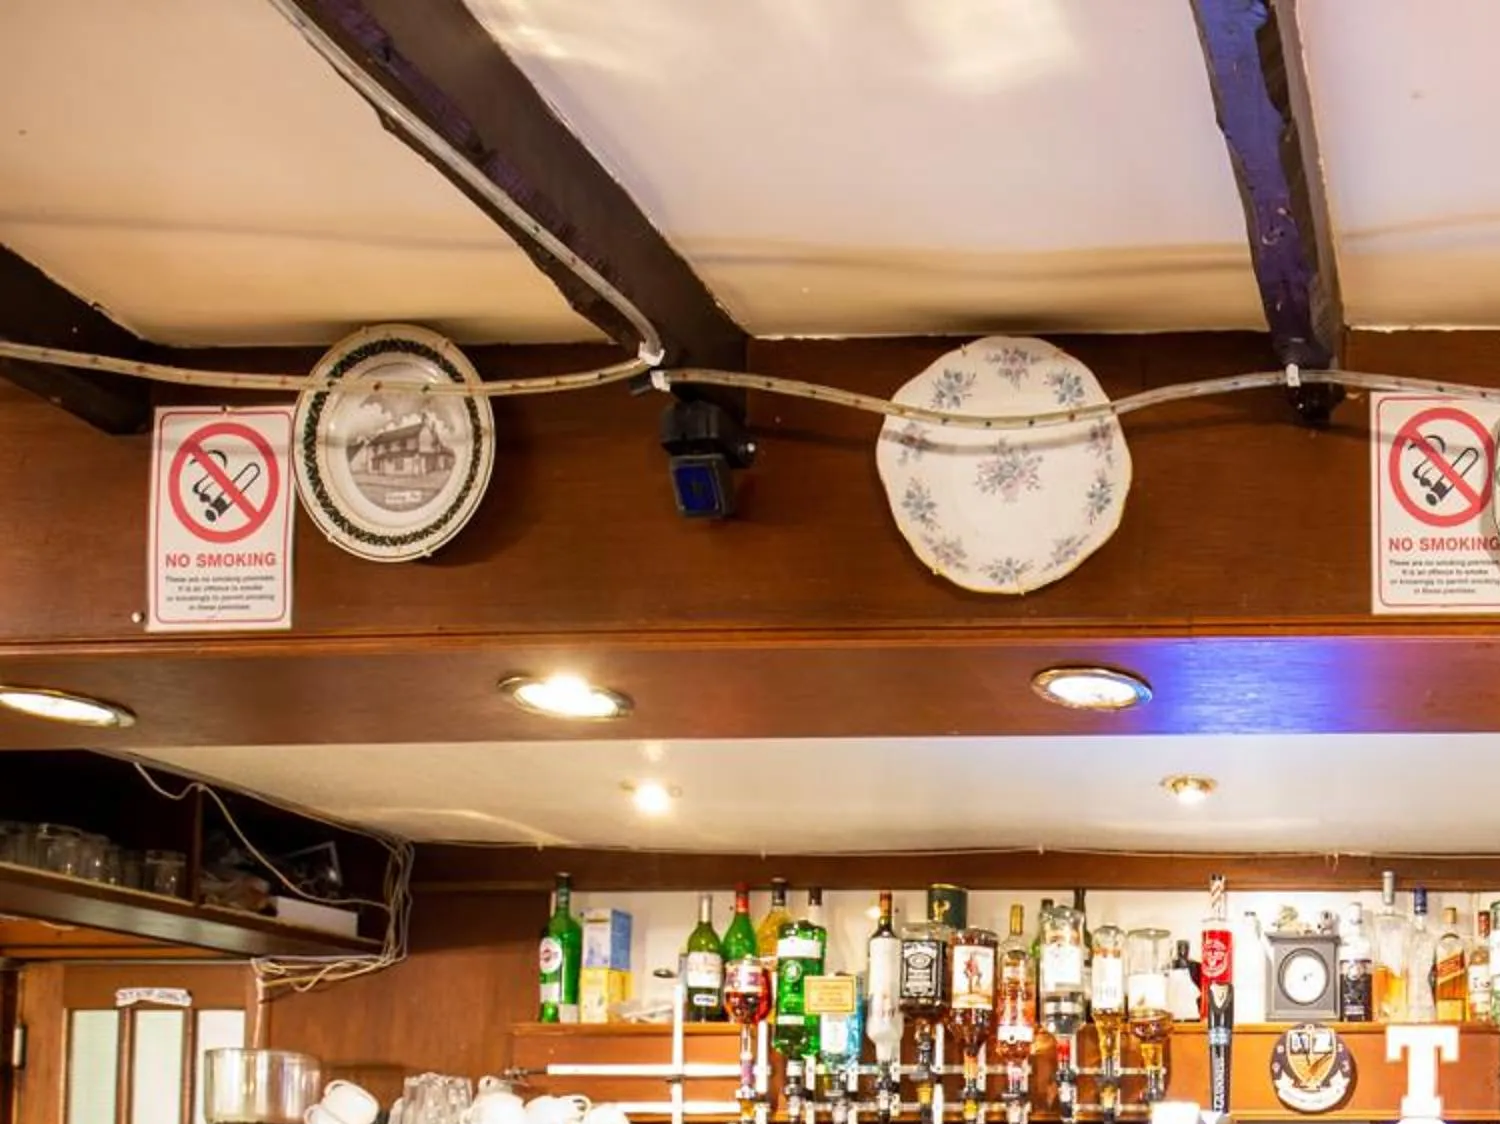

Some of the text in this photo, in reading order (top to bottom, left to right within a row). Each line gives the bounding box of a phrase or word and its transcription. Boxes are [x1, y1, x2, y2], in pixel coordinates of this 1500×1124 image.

[1389, 536, 1500, 551] NO SMOKING
[165, 551, 277, 568] NO SMOKING
